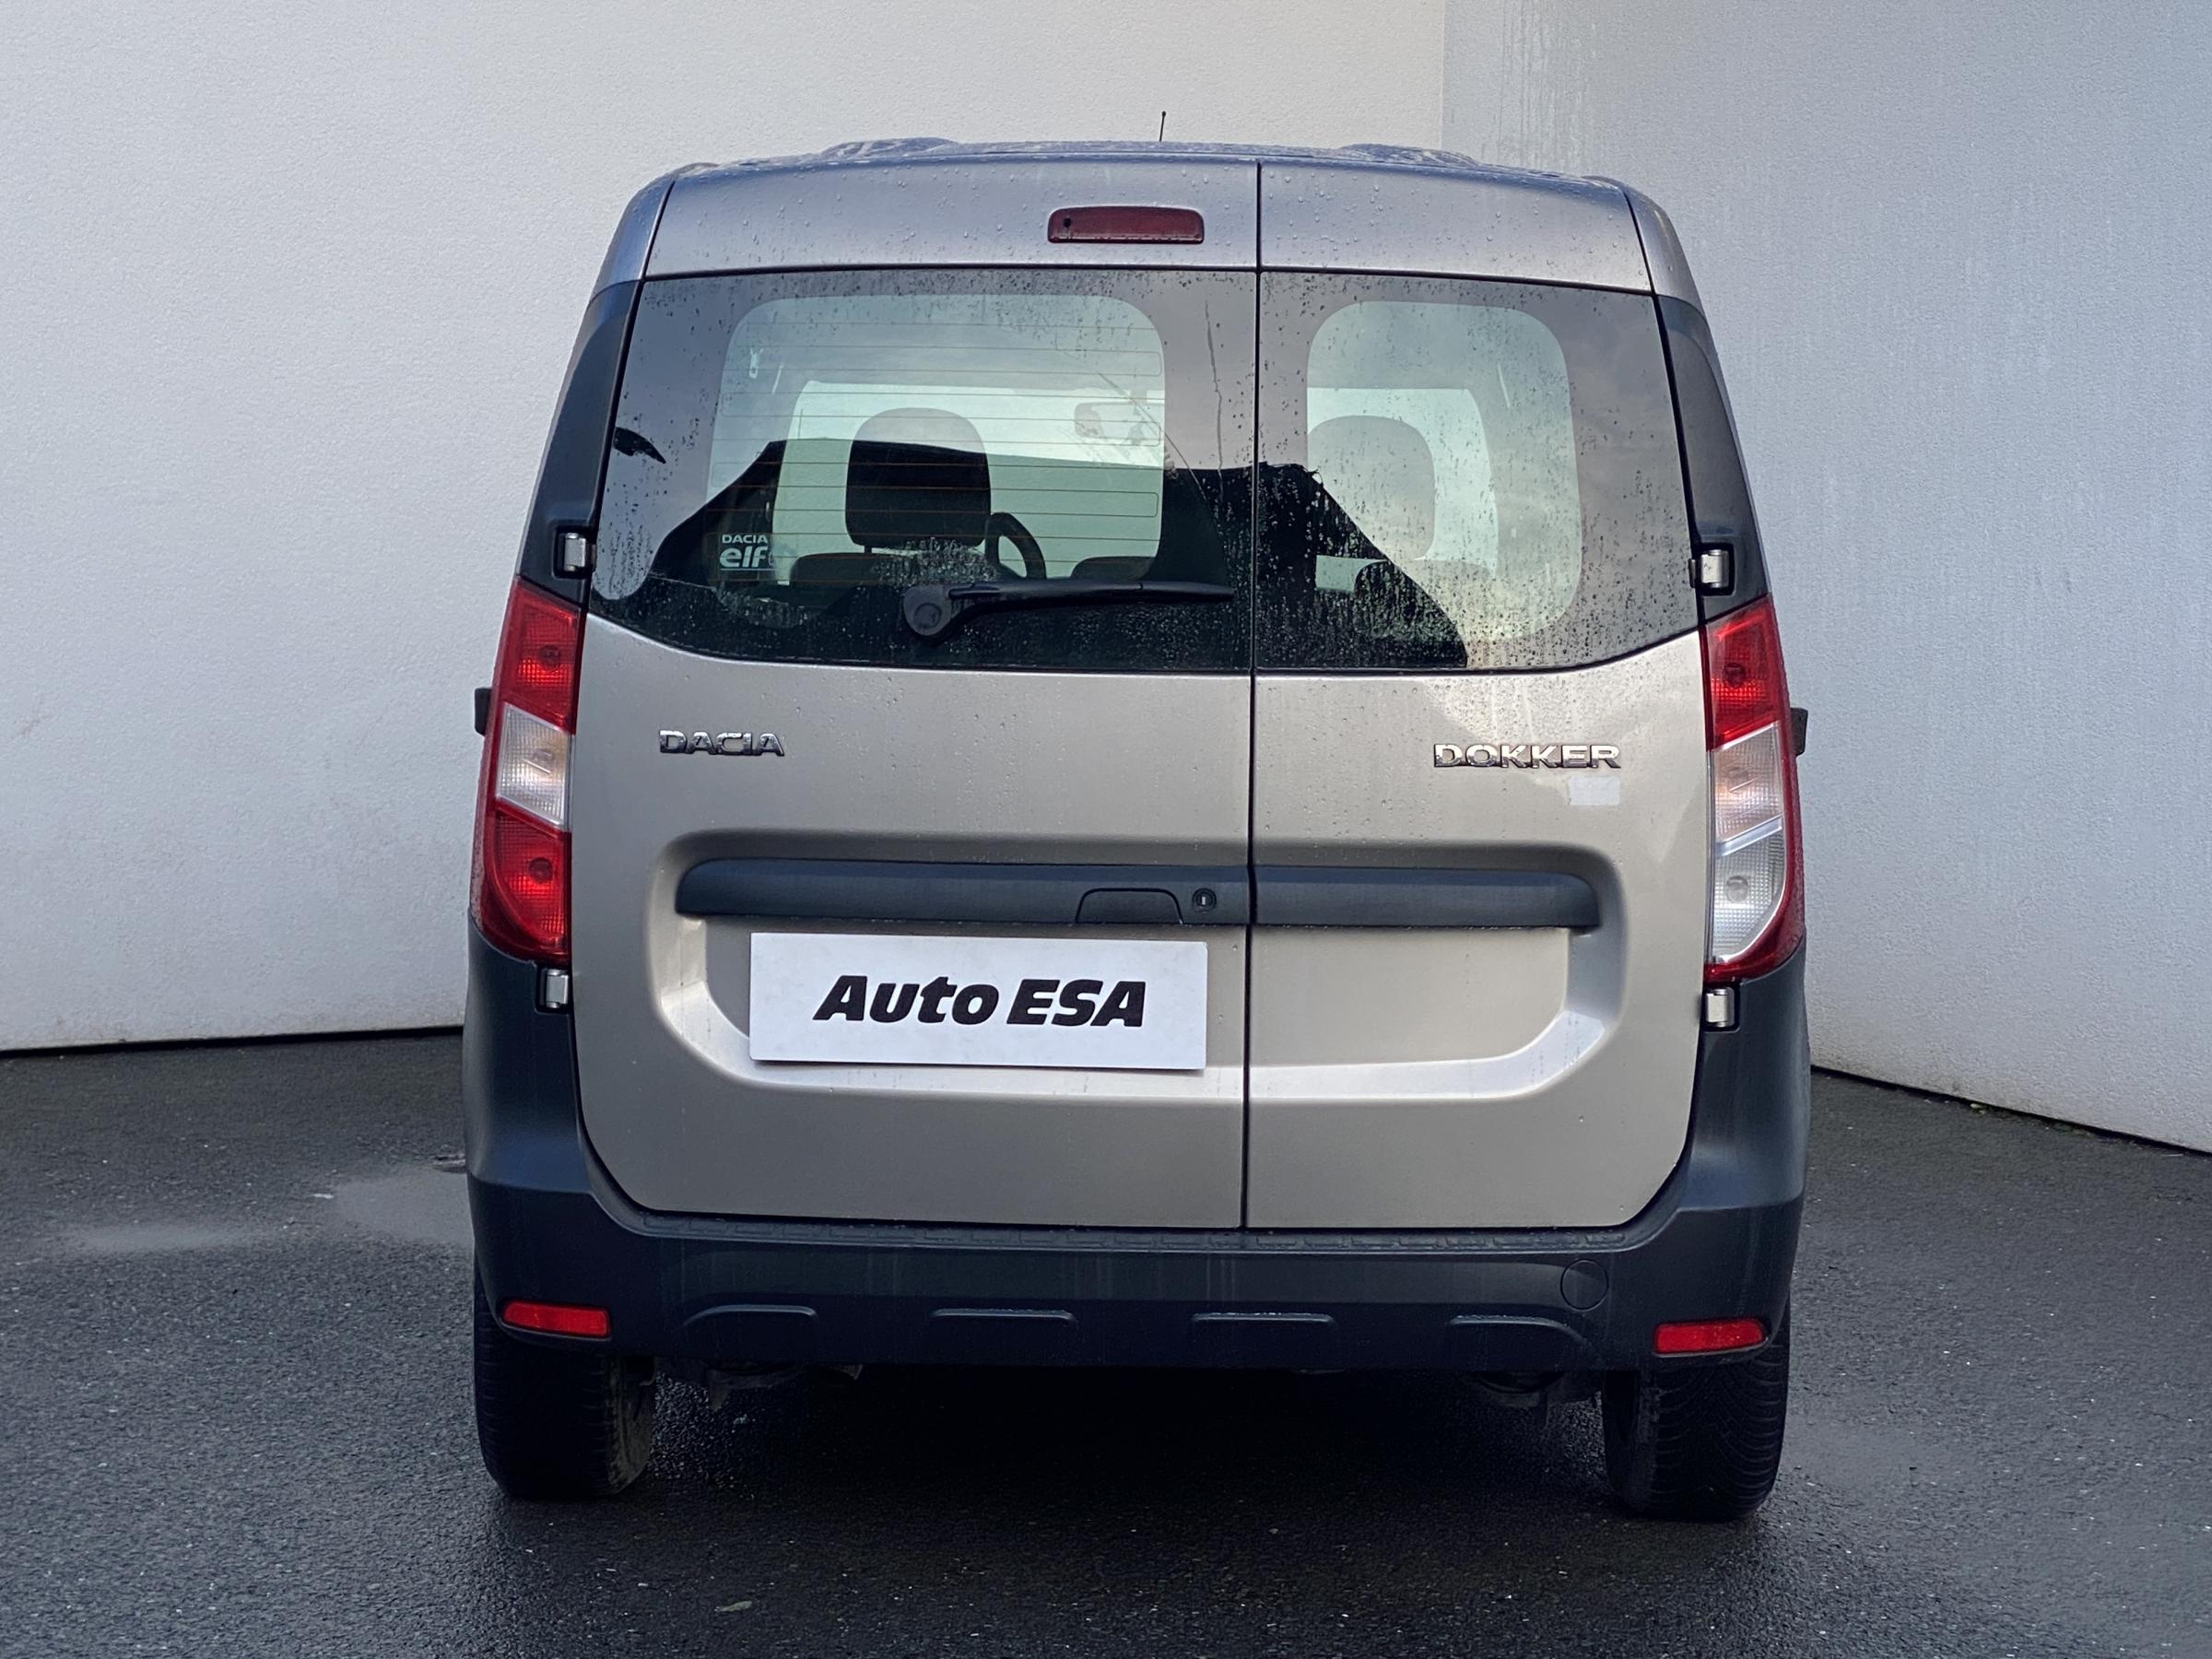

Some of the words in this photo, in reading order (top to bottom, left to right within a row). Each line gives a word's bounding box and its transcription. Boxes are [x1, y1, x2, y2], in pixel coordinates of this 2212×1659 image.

[722, 534, 769, 544] DACIA
[719, 546, 769, 568] elf
[659, 730, 785, 757] DACIA
[1433, 744, 1621, 769] DOKKER
[812, 974, 999, 1025] Auto
[1006, 979, 1147, 1027] ESA
